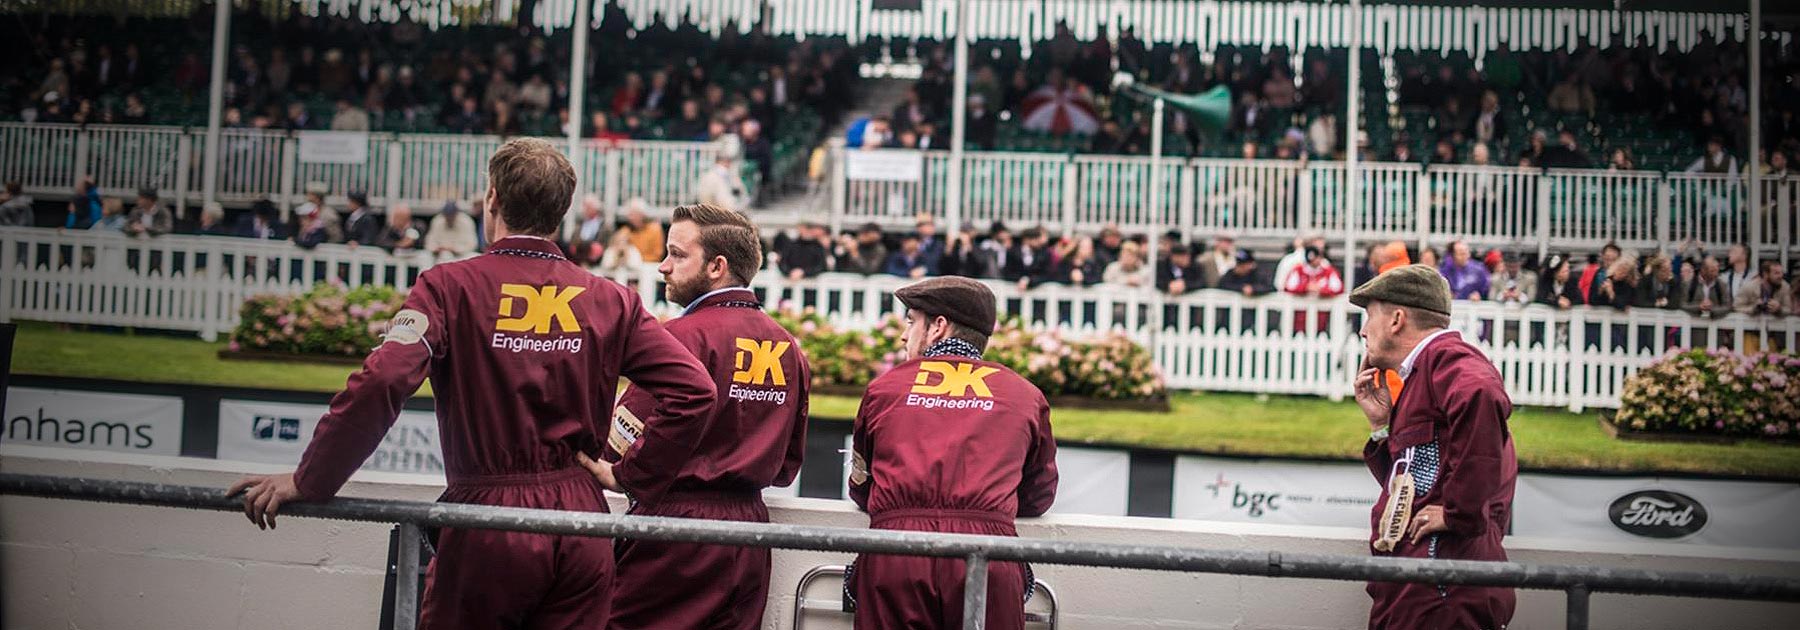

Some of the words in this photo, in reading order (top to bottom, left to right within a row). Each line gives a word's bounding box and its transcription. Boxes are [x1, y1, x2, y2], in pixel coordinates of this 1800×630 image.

[495, 283, 586, 334] DK
[491, 332, 582, 353] Engineering
[732, 337, 791, 386] DK
[728, 384, 787, 405] Engineering
[910, 361, 1000, 398] DK
[906, 394, 994, 411] Engineering
[1232, 483, 1281, 517] bgc
[1389, 485, 1409, 539] MECHANI
[1620, 496, 1694, 527] Ford
